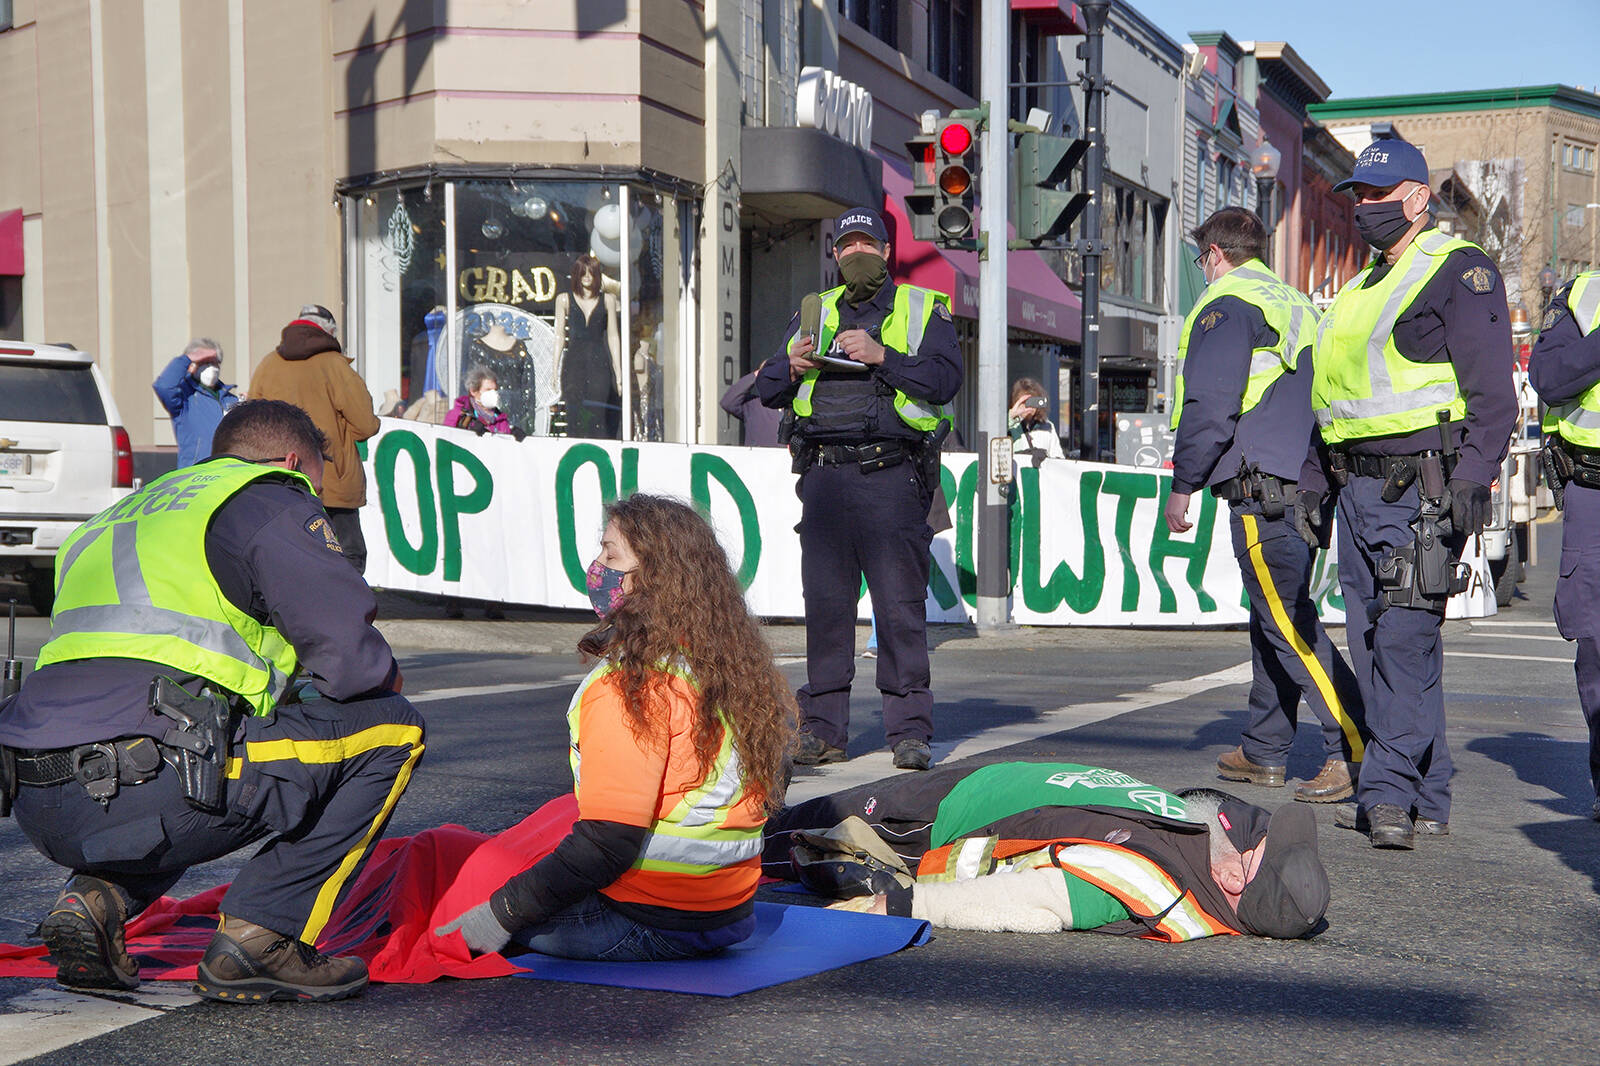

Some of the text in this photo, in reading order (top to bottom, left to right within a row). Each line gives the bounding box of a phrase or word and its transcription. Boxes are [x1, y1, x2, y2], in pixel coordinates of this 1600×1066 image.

[840, 214, 873, 229] POLICE
[460, 265, 557, 304] GRAD
[84, 484, 208, 529] OLICE
[356, 430, 494, 581] OP
[858, 459, 1218, 614] OWTH
